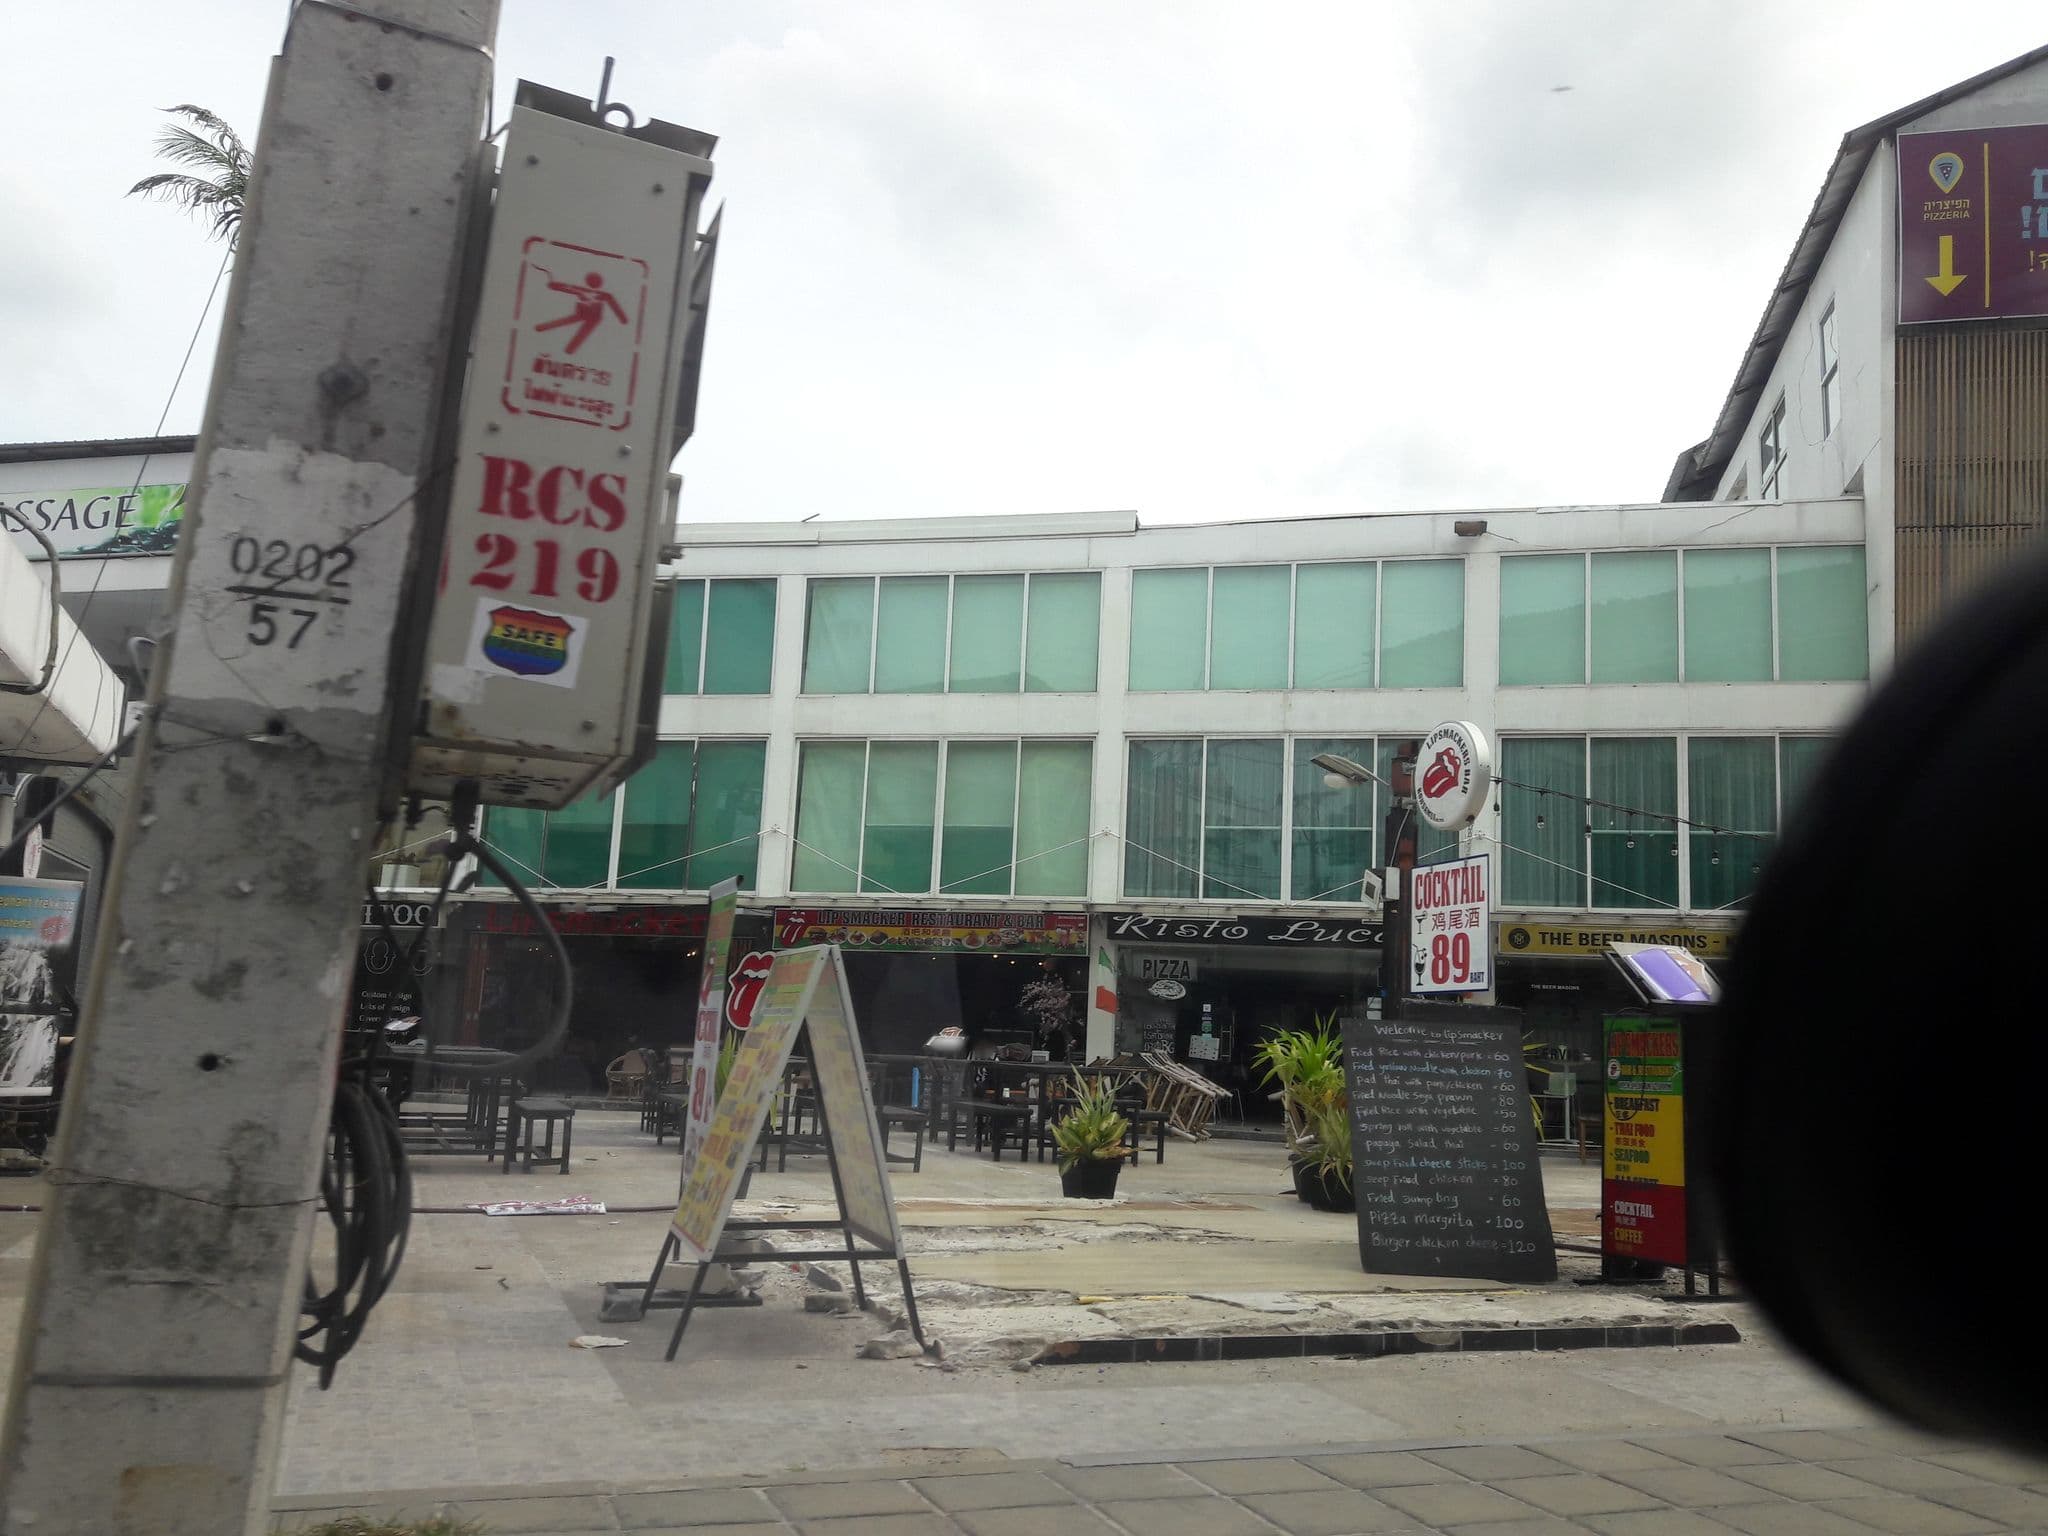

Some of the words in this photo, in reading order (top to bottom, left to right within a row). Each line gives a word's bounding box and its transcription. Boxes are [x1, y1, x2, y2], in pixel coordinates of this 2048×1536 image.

[1924, 199, 1970, 211] הפיצריה
[1923, 210, 1970, 221] PIZZERIA
[478, 455, 628, 533] RCS
[0, 494, 137, 532] SSAGE
[231, 537, 356, 588] 0202
[469, 533, 622, 604] 219
[248, 603, 318, 650] 57
[502, 623, 556, 647] SAFE
[1415, 865, 1485, 910] COCKTAIL
[911, 912, 1000, 926] RESTAURANT
[1003, 914, 1012, 927] &
[1017, 914, 1044, 928] BAR
[1113, 914, 1249, 939] Risto
[1432, 907, 1481, 931] 鸡尾酒
[1539, 932, 1573, 946] THE
[1578, 932, 1624, 947] BEER
[1630, 933, 1707, 949] MASONS
[1431, 932, 1470, 984] 89
[1470, 972, 1485, 984] BAHT
[1142, 959, 1191, 980] PIZZA
[1374, 1025, 1427, 1036] Welcome
[1351, 1047, 1374, 1057] Fried
[1402, 1049, 1421, 1058] with
[1352, 1061, 1374, 1071] Fried
[1352, 1091, 1374, 1100] Fried
[1615, 1121, 1633, 1136] THAI
[1634, 1123, 1655, 1138] FOOD
[1419, 1158, 1451, 1169] cheese
[1429, 1174, 1473, 1185] chicken
[1367, 1190, 1394, 1203] Fried
[1614, 1200, 1655, 1218] COCKTAIL
[1371, 1232, 1410, 1251] Burger
[1415, 1235, 1459, 1248] chicken
[1614, 1228, 1642, 1244] COFFEE
